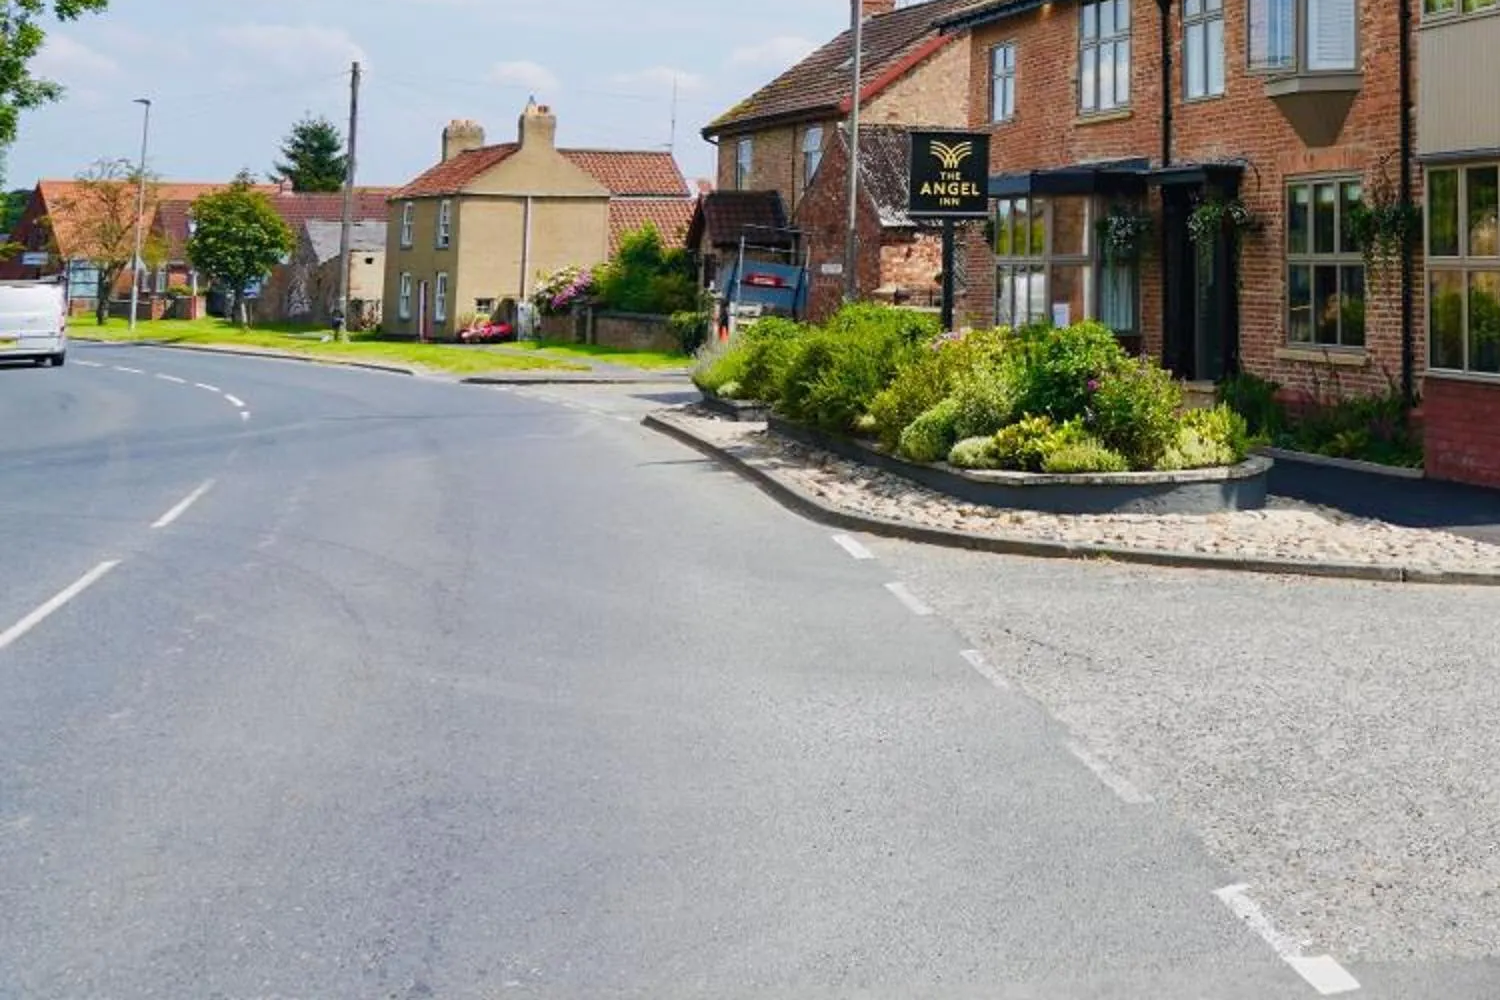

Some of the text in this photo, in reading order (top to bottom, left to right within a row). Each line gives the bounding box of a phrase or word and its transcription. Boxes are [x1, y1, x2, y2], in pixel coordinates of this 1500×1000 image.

[940, 171, 961, 181] THE
[920, 182, 980, 195] ANGEL
[939, 198, 960, 206] INN
